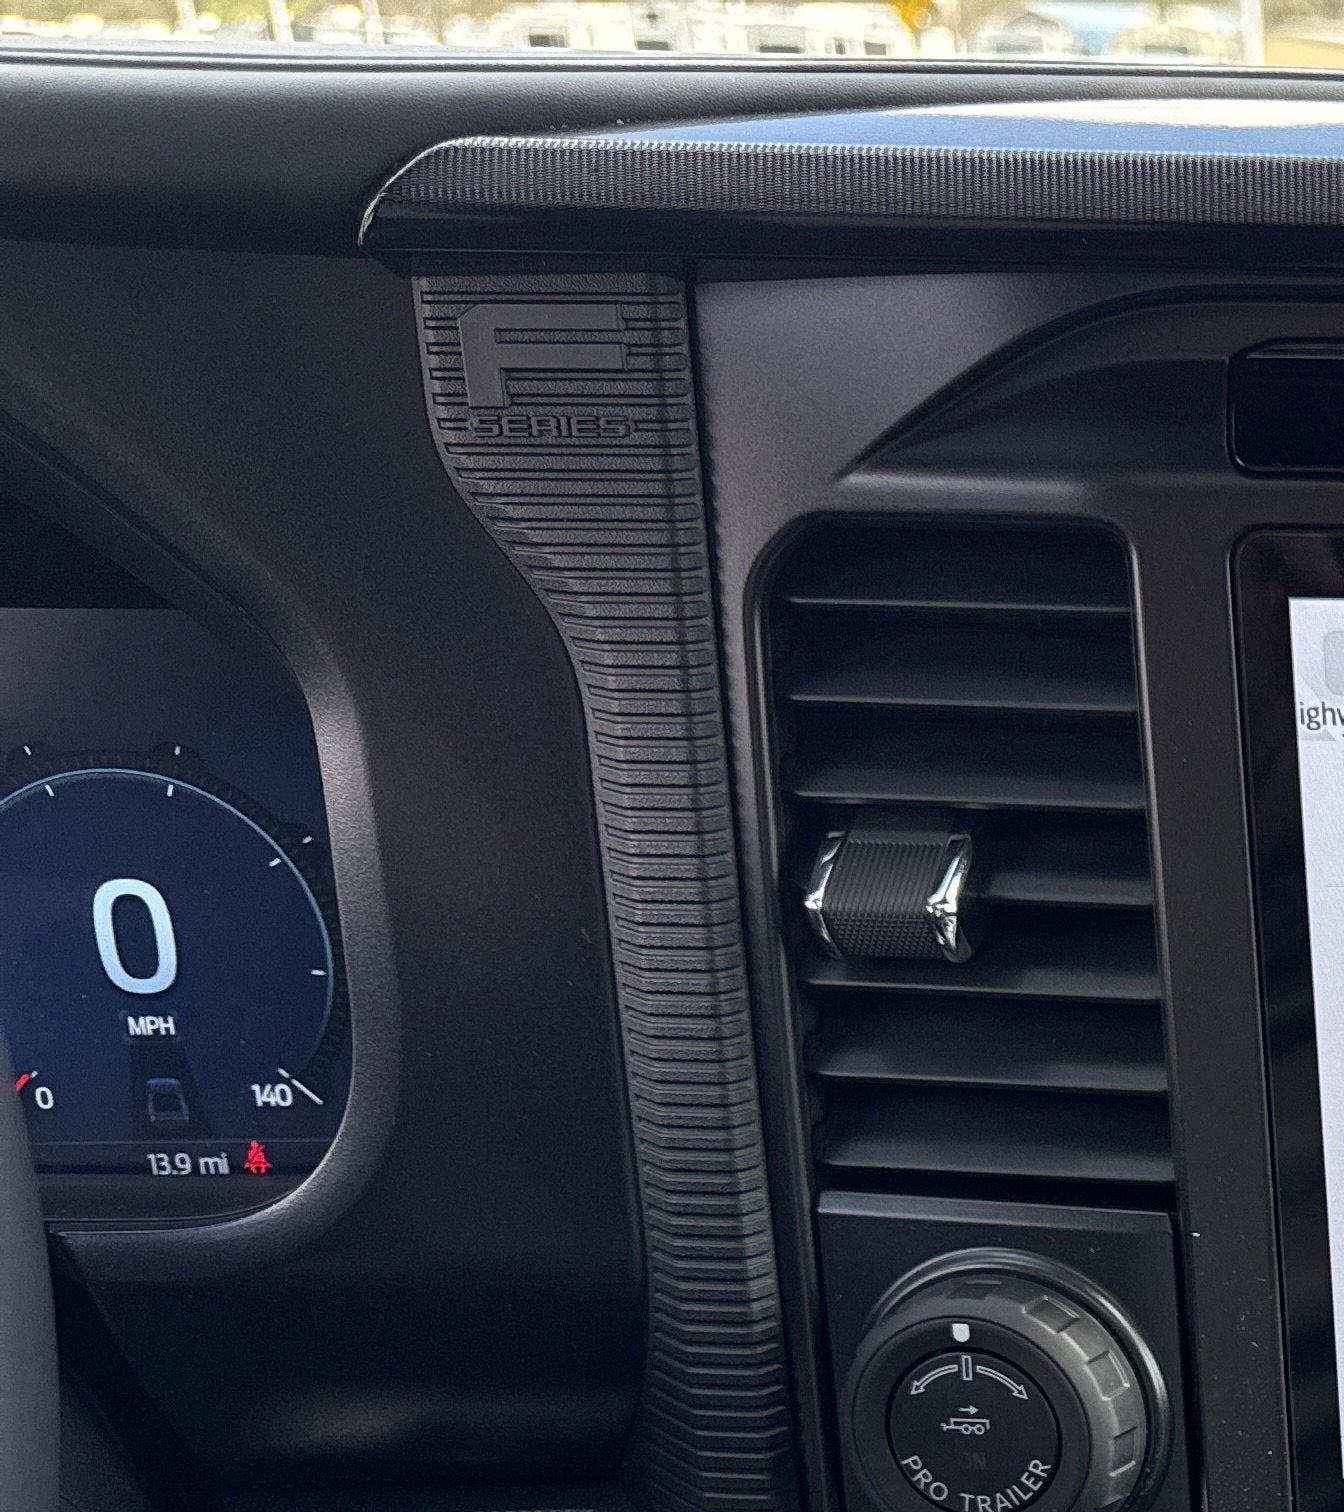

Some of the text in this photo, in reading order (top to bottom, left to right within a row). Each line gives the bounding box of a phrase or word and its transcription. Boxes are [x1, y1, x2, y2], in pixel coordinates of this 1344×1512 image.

[471, 415, 632, 439] SERIES
[93, 877, 178, 995] 0
[127, 1015, 177, 1037] MPH
[34, 1086, 55, 1110] 0
[250, 1083, 293, 1107] 140
[147, 1152, 229, 1176] 13.9 mi
[900, 1455, 949, 1502] PRO
